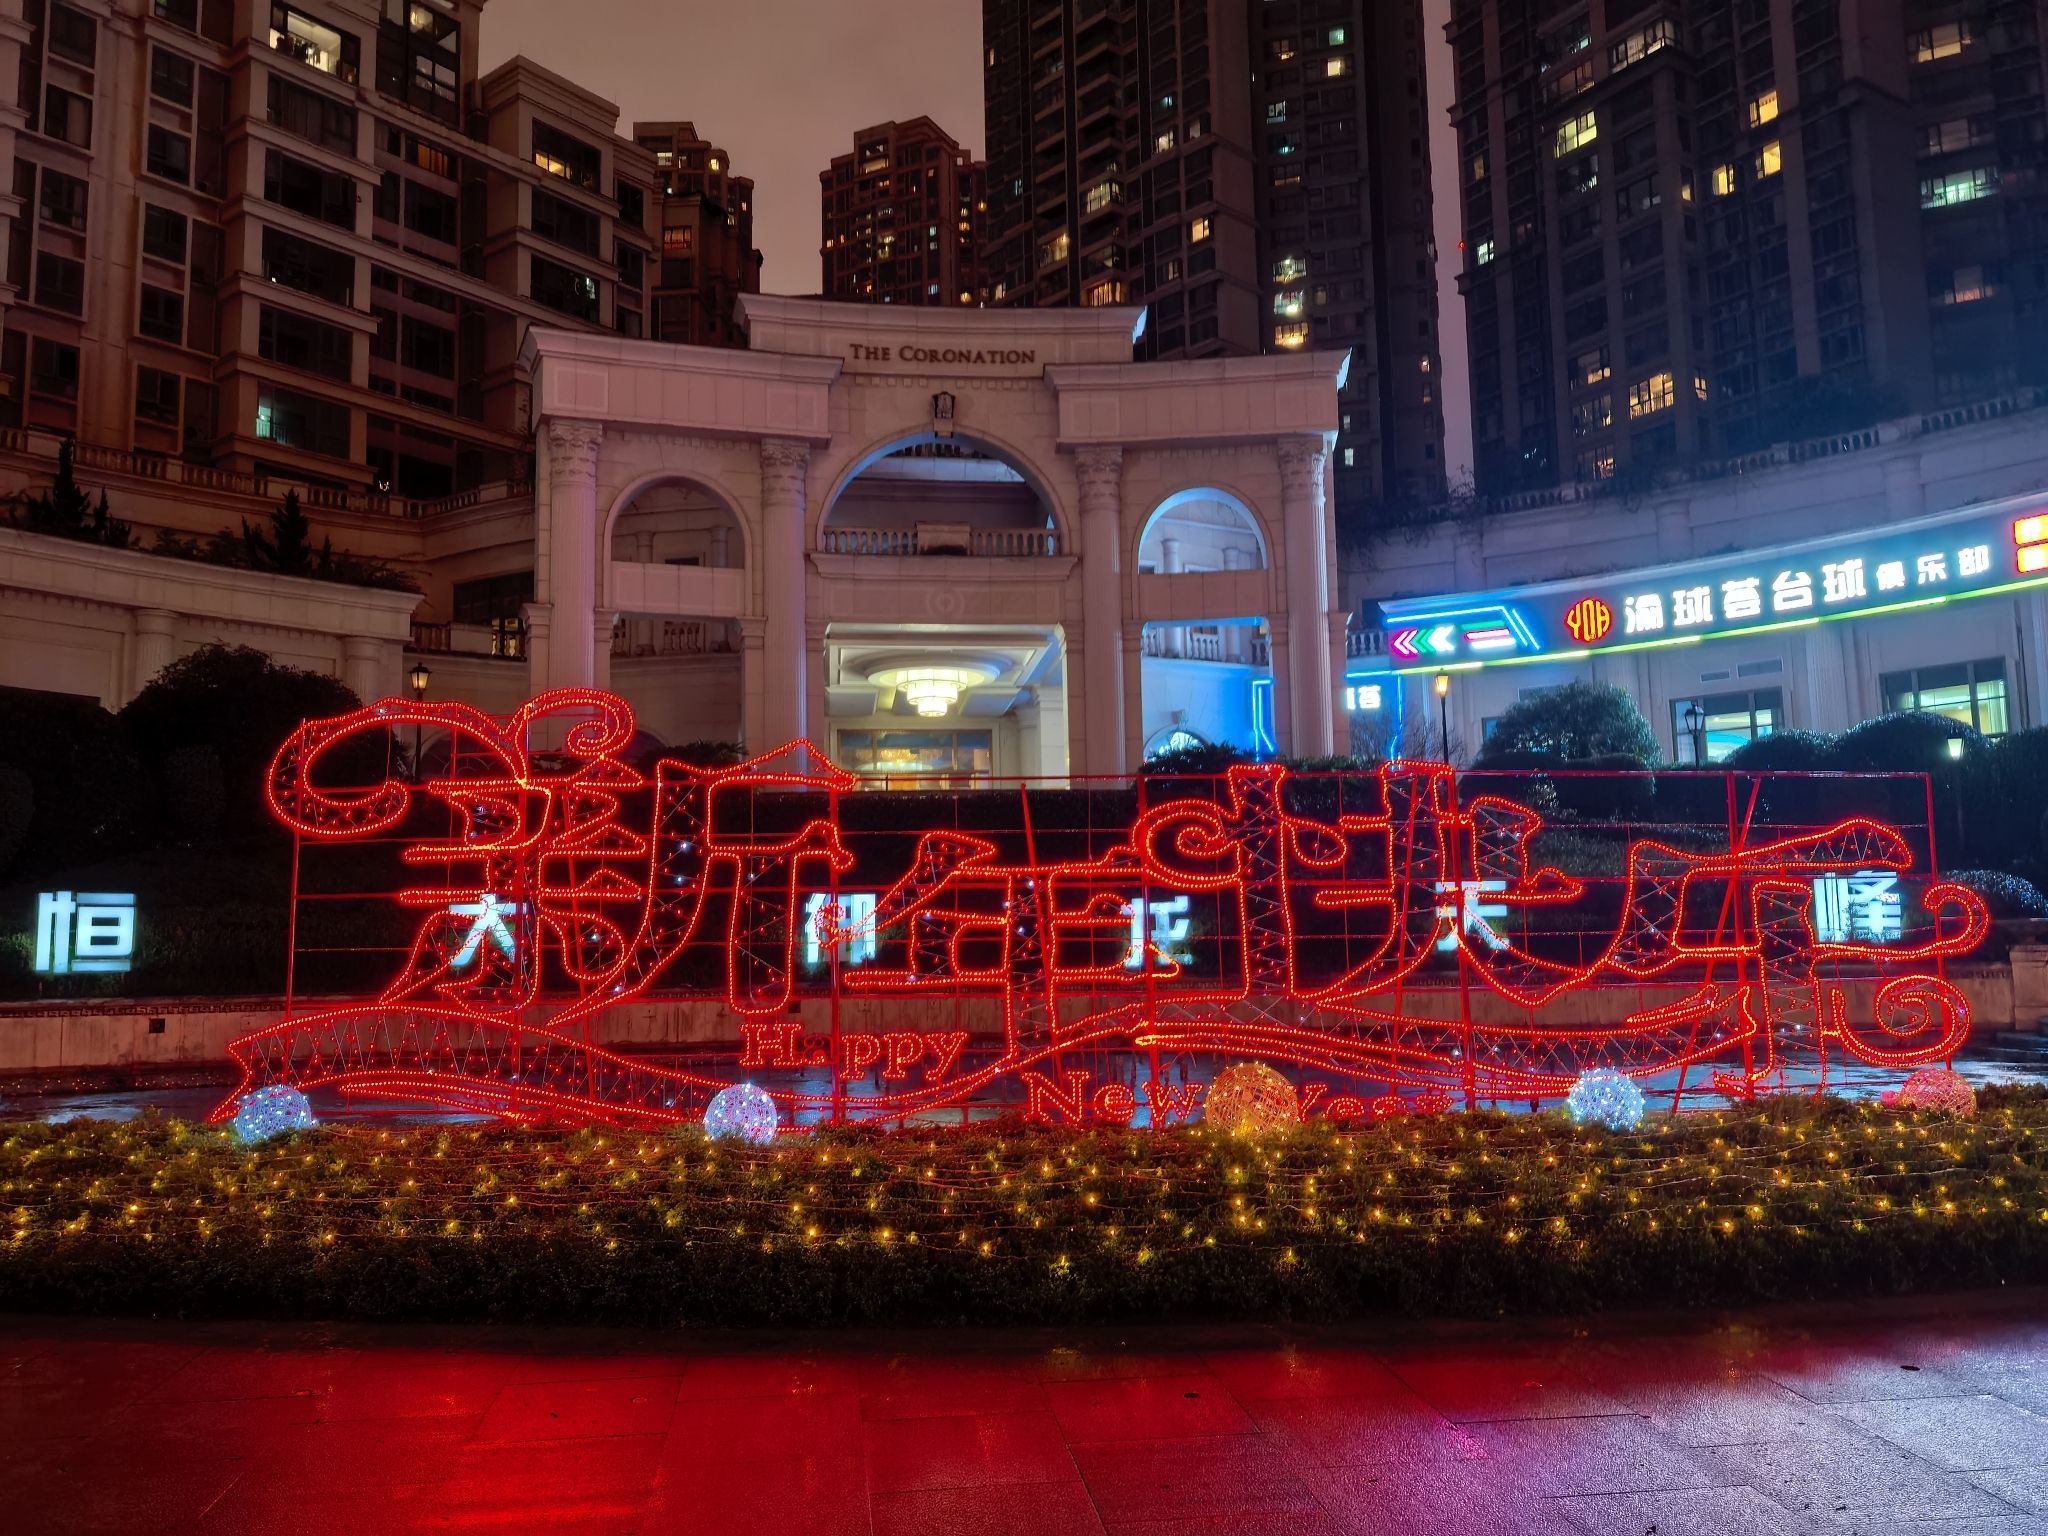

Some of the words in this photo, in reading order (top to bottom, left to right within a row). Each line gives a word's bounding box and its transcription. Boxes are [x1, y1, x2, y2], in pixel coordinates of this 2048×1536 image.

[850, 343, 890, 361] THE
[899, 345, 1036, 364] CORONATION
[739, 1023, 968, 1080] Happy
[1020, 1070, 1202, 1130] New
